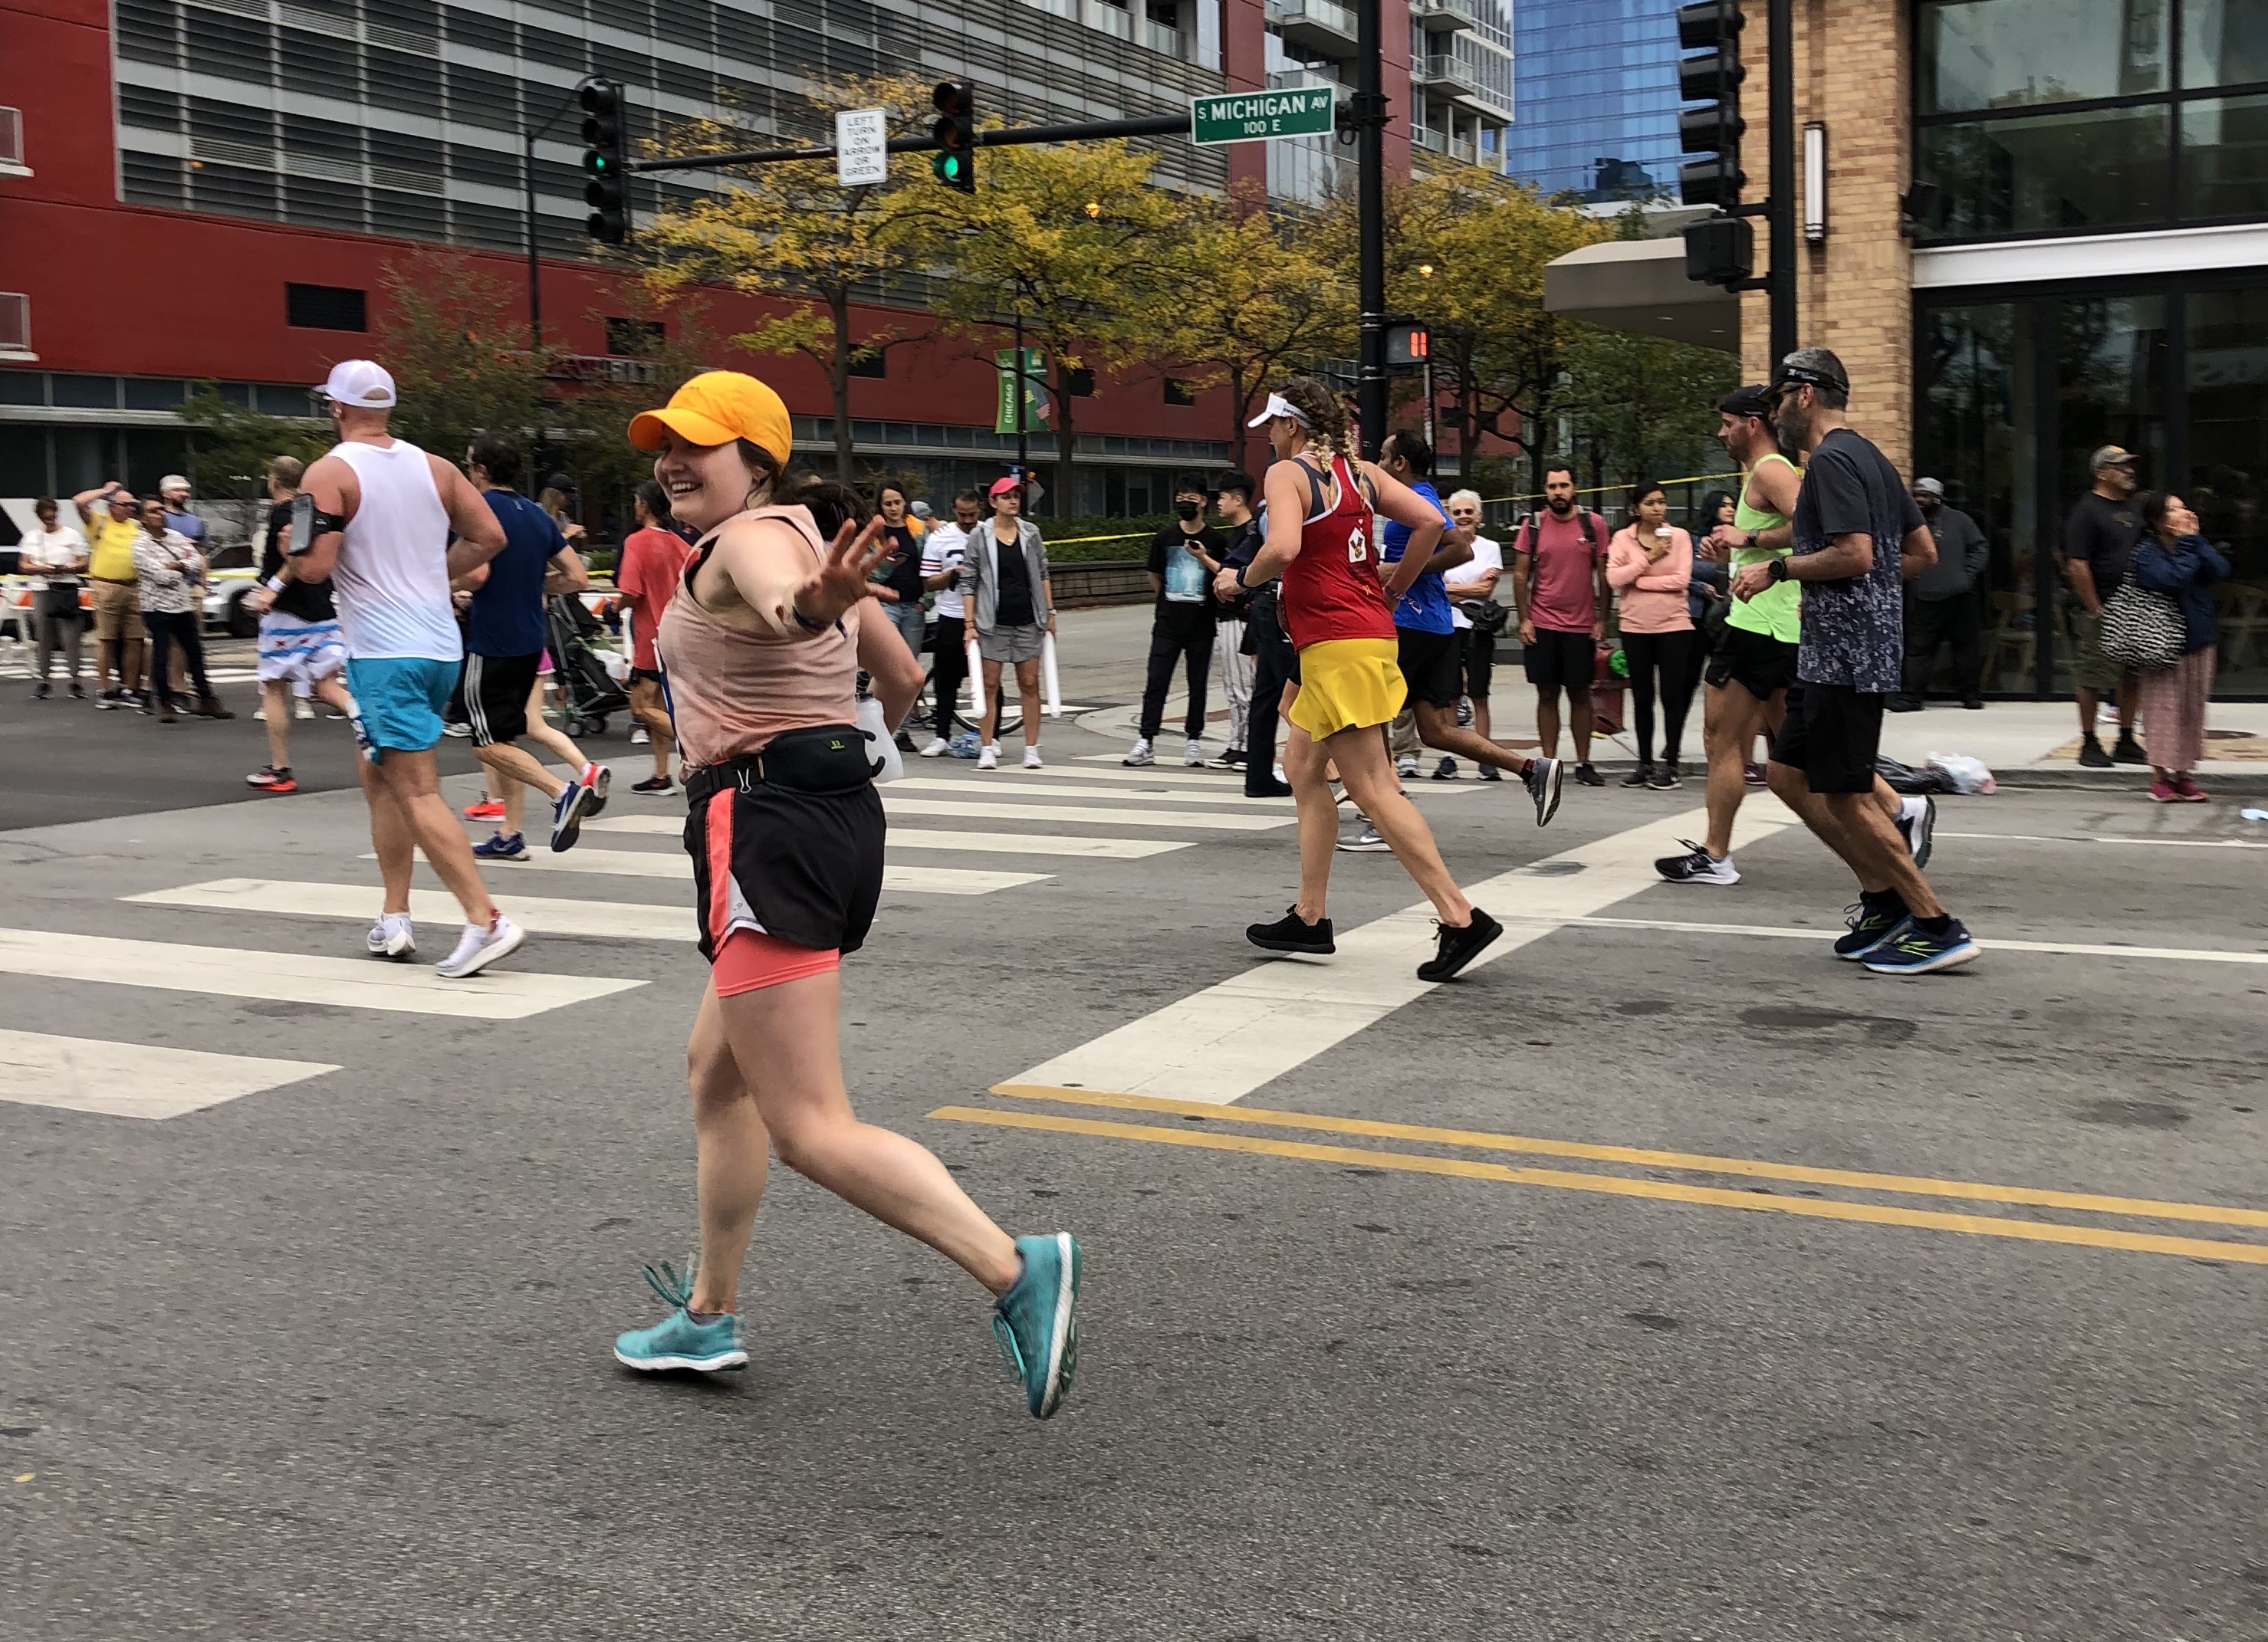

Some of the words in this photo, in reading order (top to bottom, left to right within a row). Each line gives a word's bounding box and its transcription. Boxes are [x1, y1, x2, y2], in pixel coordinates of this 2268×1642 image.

[1198, 107, 1207, 120] S
[1211, 95, 1306, 121] MICHIGAN
[1310, 96, 1329, 110] AV
[846, 116, 874, 126] LEFT
[846, 126, 876, 136] TURN
[1243, 120, 1267, 134] 100
[1271, 119, 1282, 132] E
[853, 136, 869, 146] ON
[854, 156, 869, 165] OR
[844, 166, 880, 176] GREEN
[1410, 331, 1427, 358] 11
[1004, 384, 1014, 423] CHICAGO
